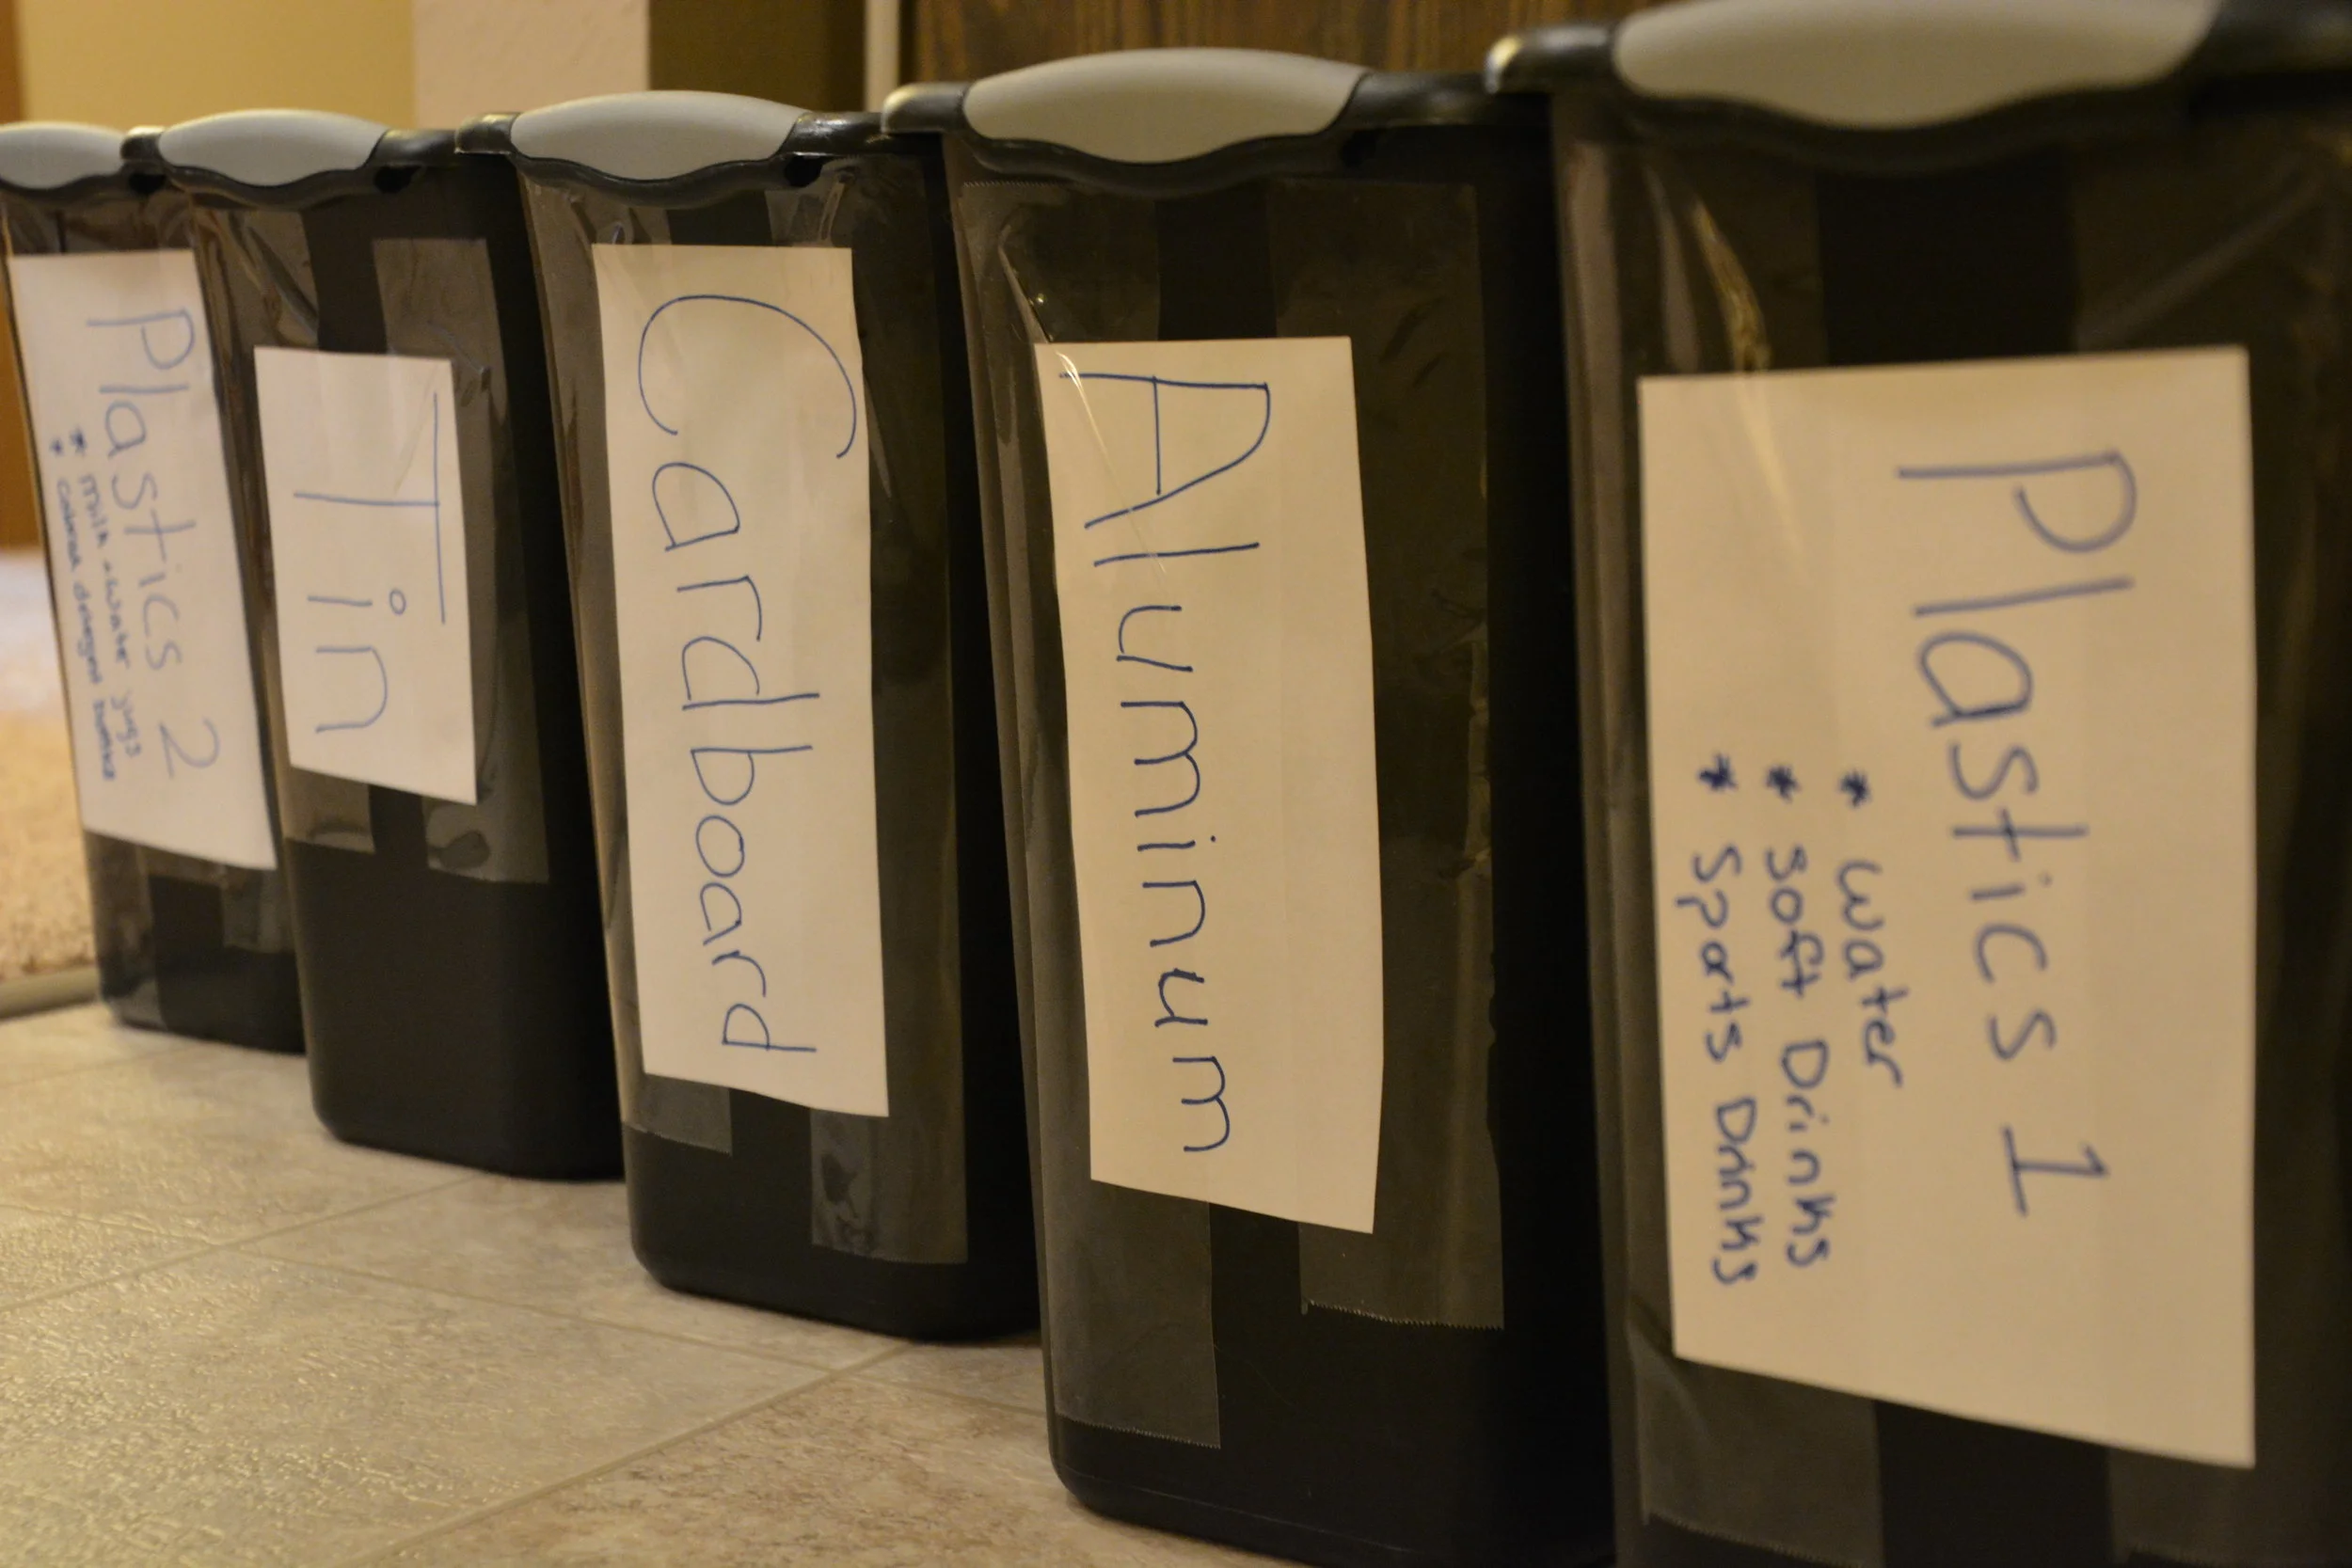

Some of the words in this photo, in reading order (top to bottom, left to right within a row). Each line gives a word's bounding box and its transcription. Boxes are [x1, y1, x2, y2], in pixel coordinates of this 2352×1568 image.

[87, 309, 196, 672] Plastics
[158, 719, 221, 779] 2
[294, 392, 446, 735] Tin
[637, 294, 858, 1055] Cardboard
[1058, 371, 1272, 1155] Aluminum
[1897, 451, 2141, 1062] Plastics
[1780, 1037, 1836, 1268] Drinks
[1999, 1126, 2109, 1218] 1
